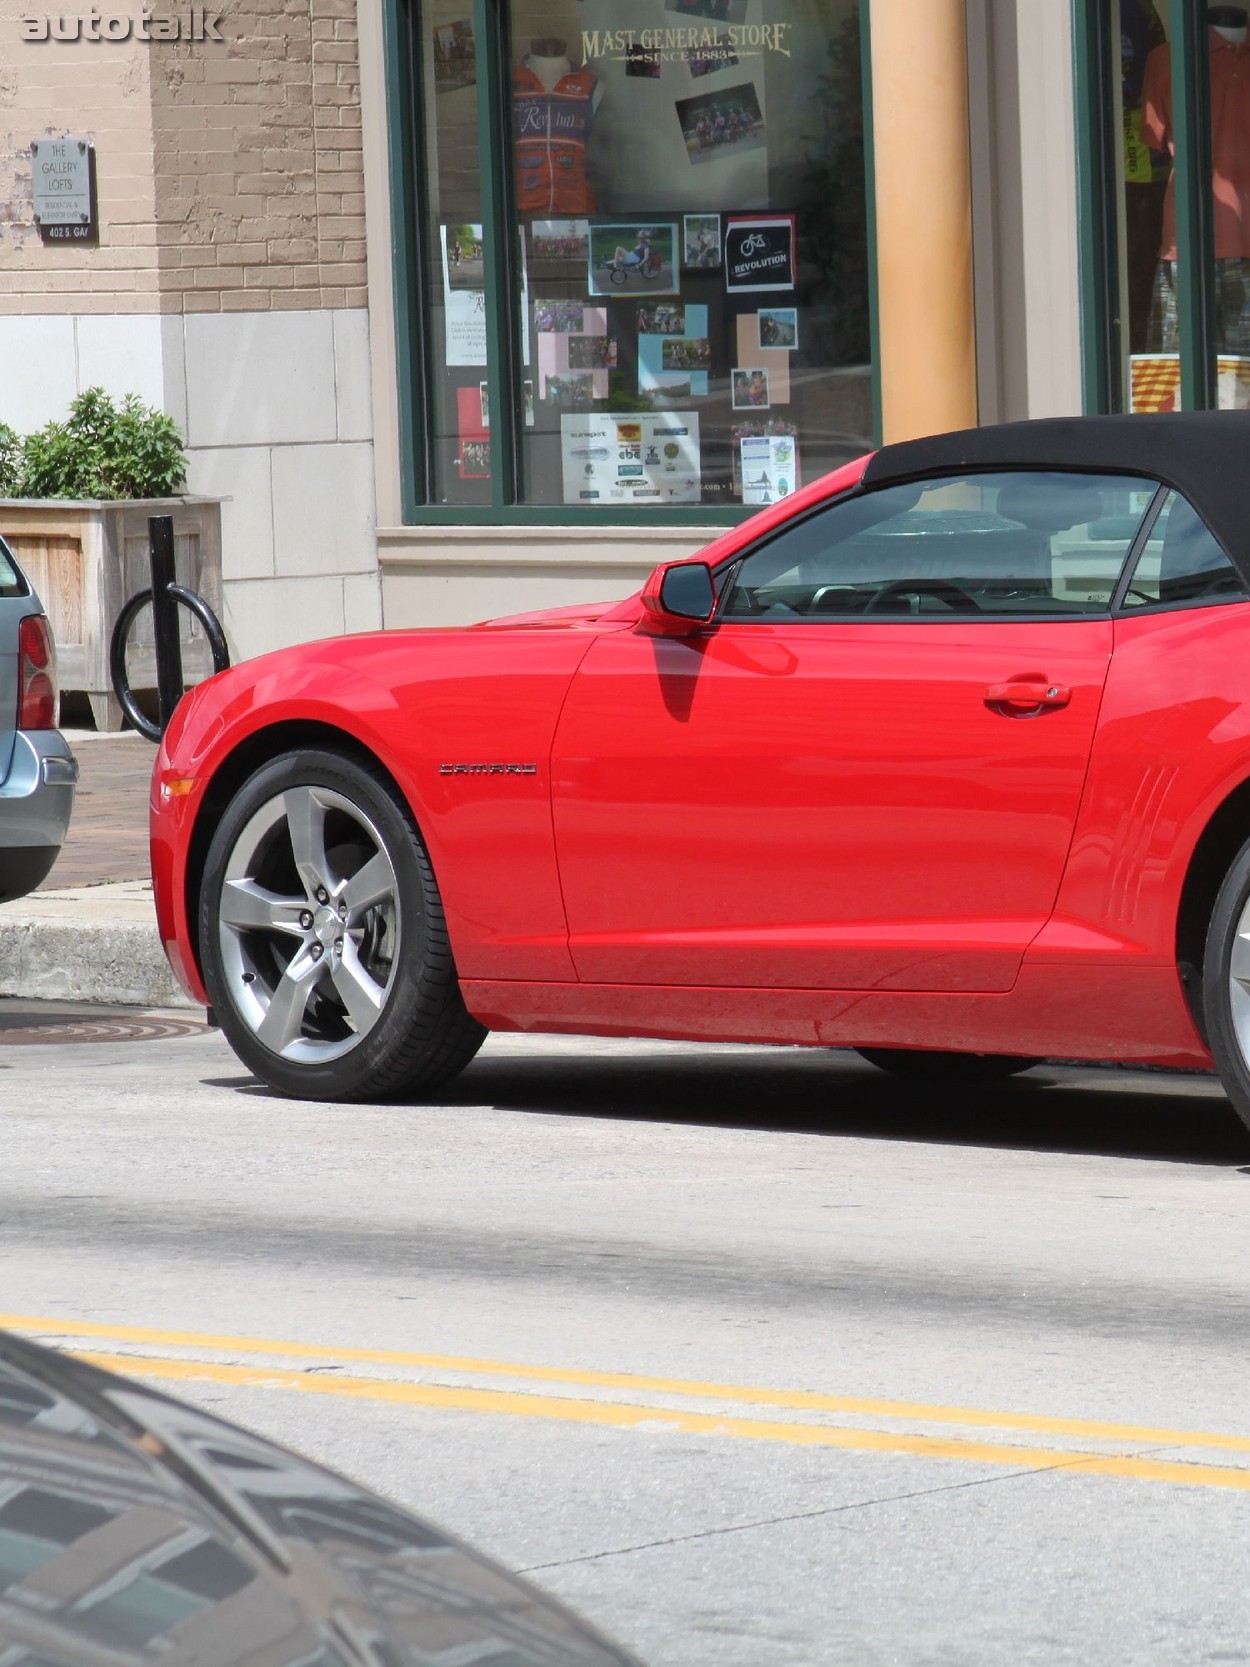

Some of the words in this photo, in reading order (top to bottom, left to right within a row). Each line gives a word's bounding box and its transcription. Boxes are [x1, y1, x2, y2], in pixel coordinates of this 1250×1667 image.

[581, 29, 636, 67] MAST
[640, 26, 723, 50] GENERAL
[727, 23, 792, 58] STORE
[643, 51, 689, 63] SINCE
[693, 50, 729, 61] 1883
[51, 145, 67, 157] THE
[41, 161, 78, 174] GALLERY
[48, 179, 73, 191] LOFTS
[49, 227, 64, 238] 402
[65, 227, 72, 237] S.
[73, 226, 88, 237] GAY
[734, 253, 787, 273] REVOLUTION
[439, 763, 537, 773] CAMARO
